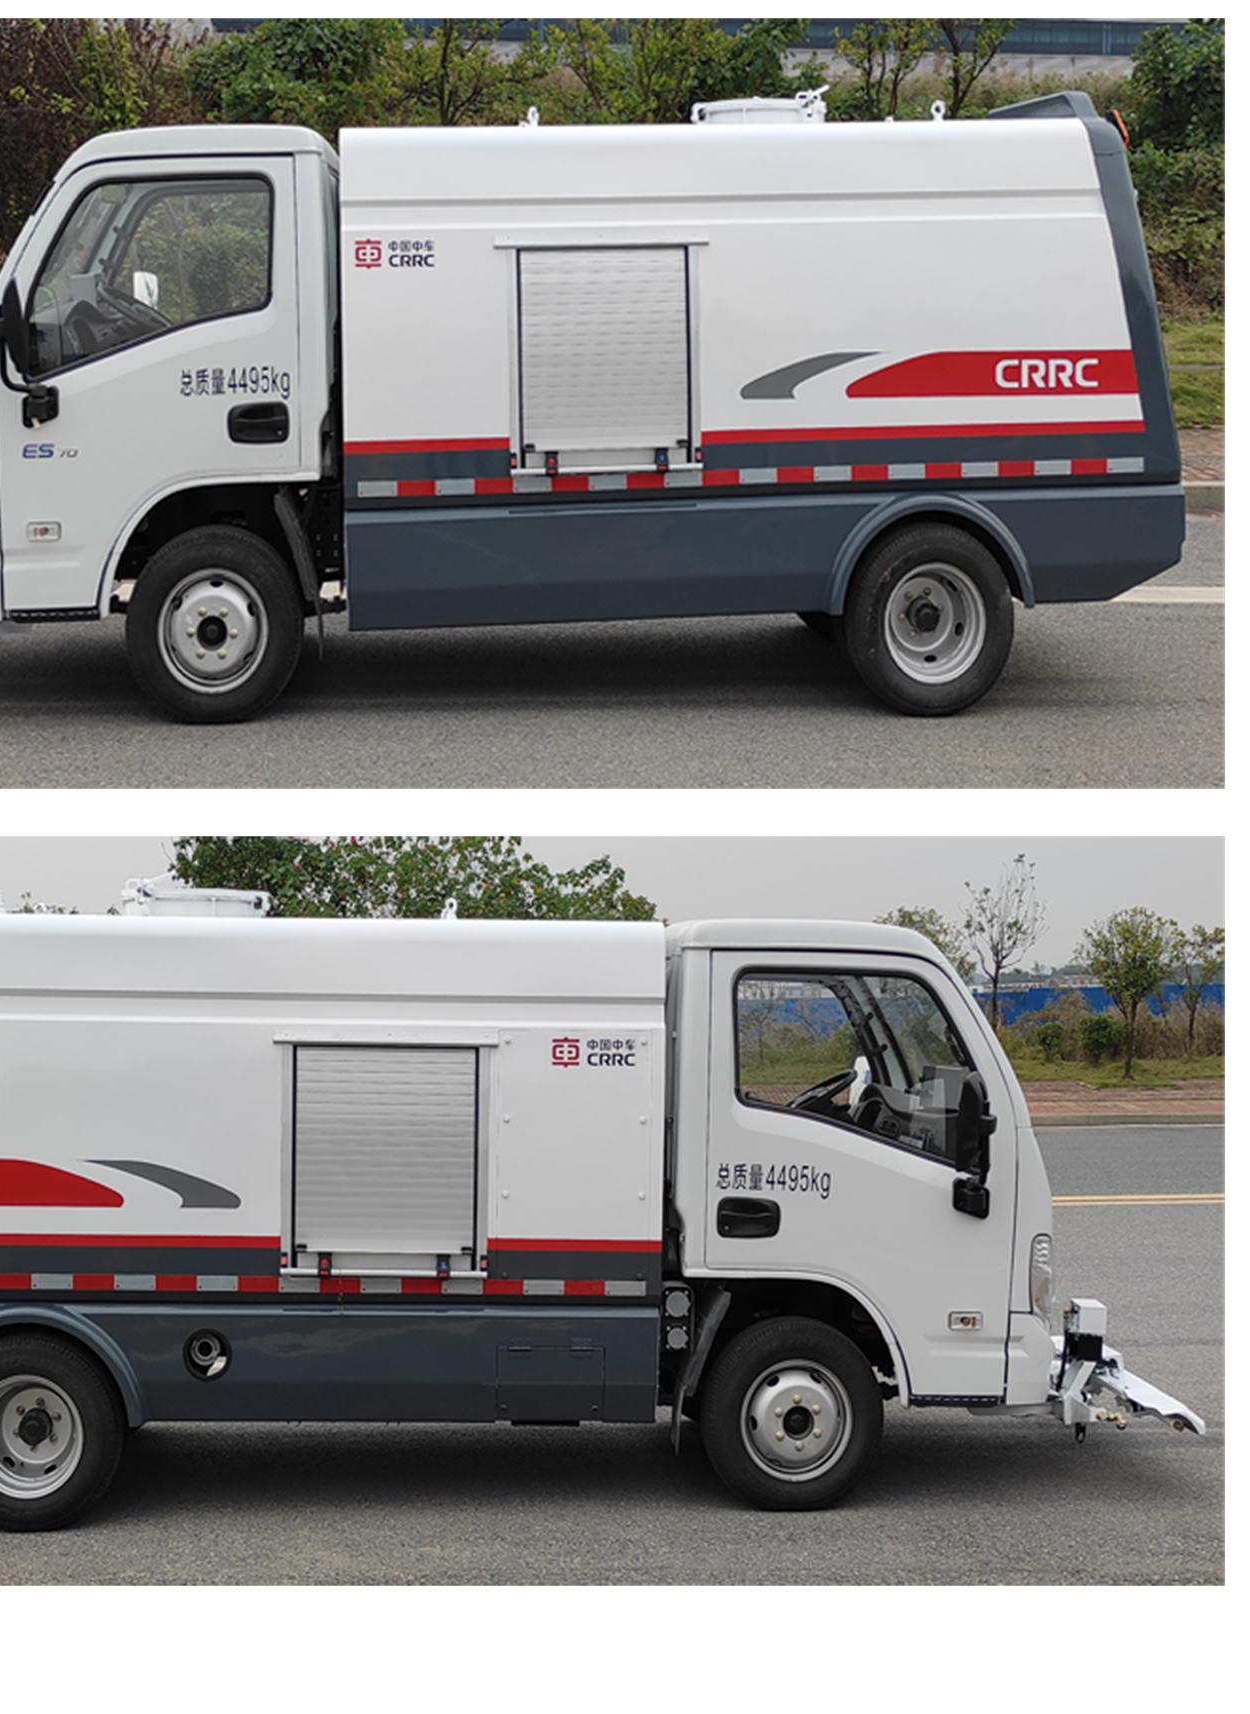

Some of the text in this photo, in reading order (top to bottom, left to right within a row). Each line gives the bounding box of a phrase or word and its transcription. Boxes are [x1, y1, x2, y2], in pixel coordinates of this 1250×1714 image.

[388, 240, 435, 252] 中国中车
[388, 254, 435, 267] CRRC
[995, 358, 1099, 388] CRRC
[180, 366, 291, 399] 总质量4495kg
[586, 1038, 636, 1051] 中国中车
[587, 1053, 636, 1066] CRRC
[716, 1163, 831, 1199] 总质量4495kg
